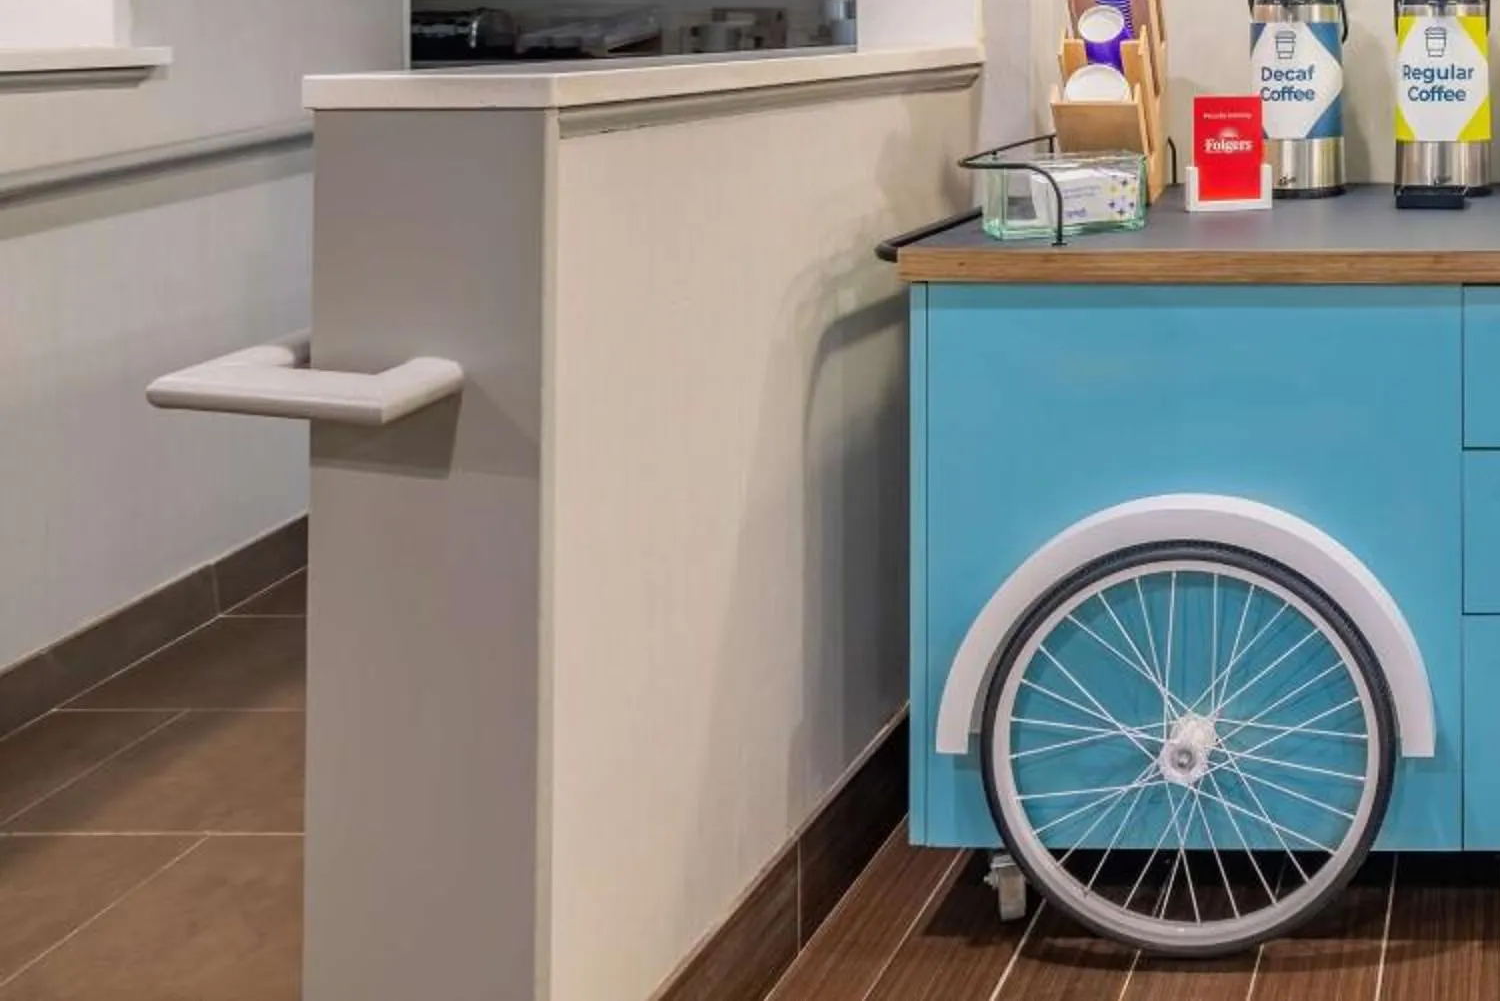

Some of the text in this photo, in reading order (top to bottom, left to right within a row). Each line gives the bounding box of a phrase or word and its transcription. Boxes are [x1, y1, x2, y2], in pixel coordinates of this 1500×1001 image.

[1261, 63, 1316, 81] Decaf
[1402, 63, 1475, 84] Regular
[1260, 85, 1316, 102] Coffee
[1407, 85, 1467, 102] Coffee
[1203, 137, 1255, 154] Folgers
